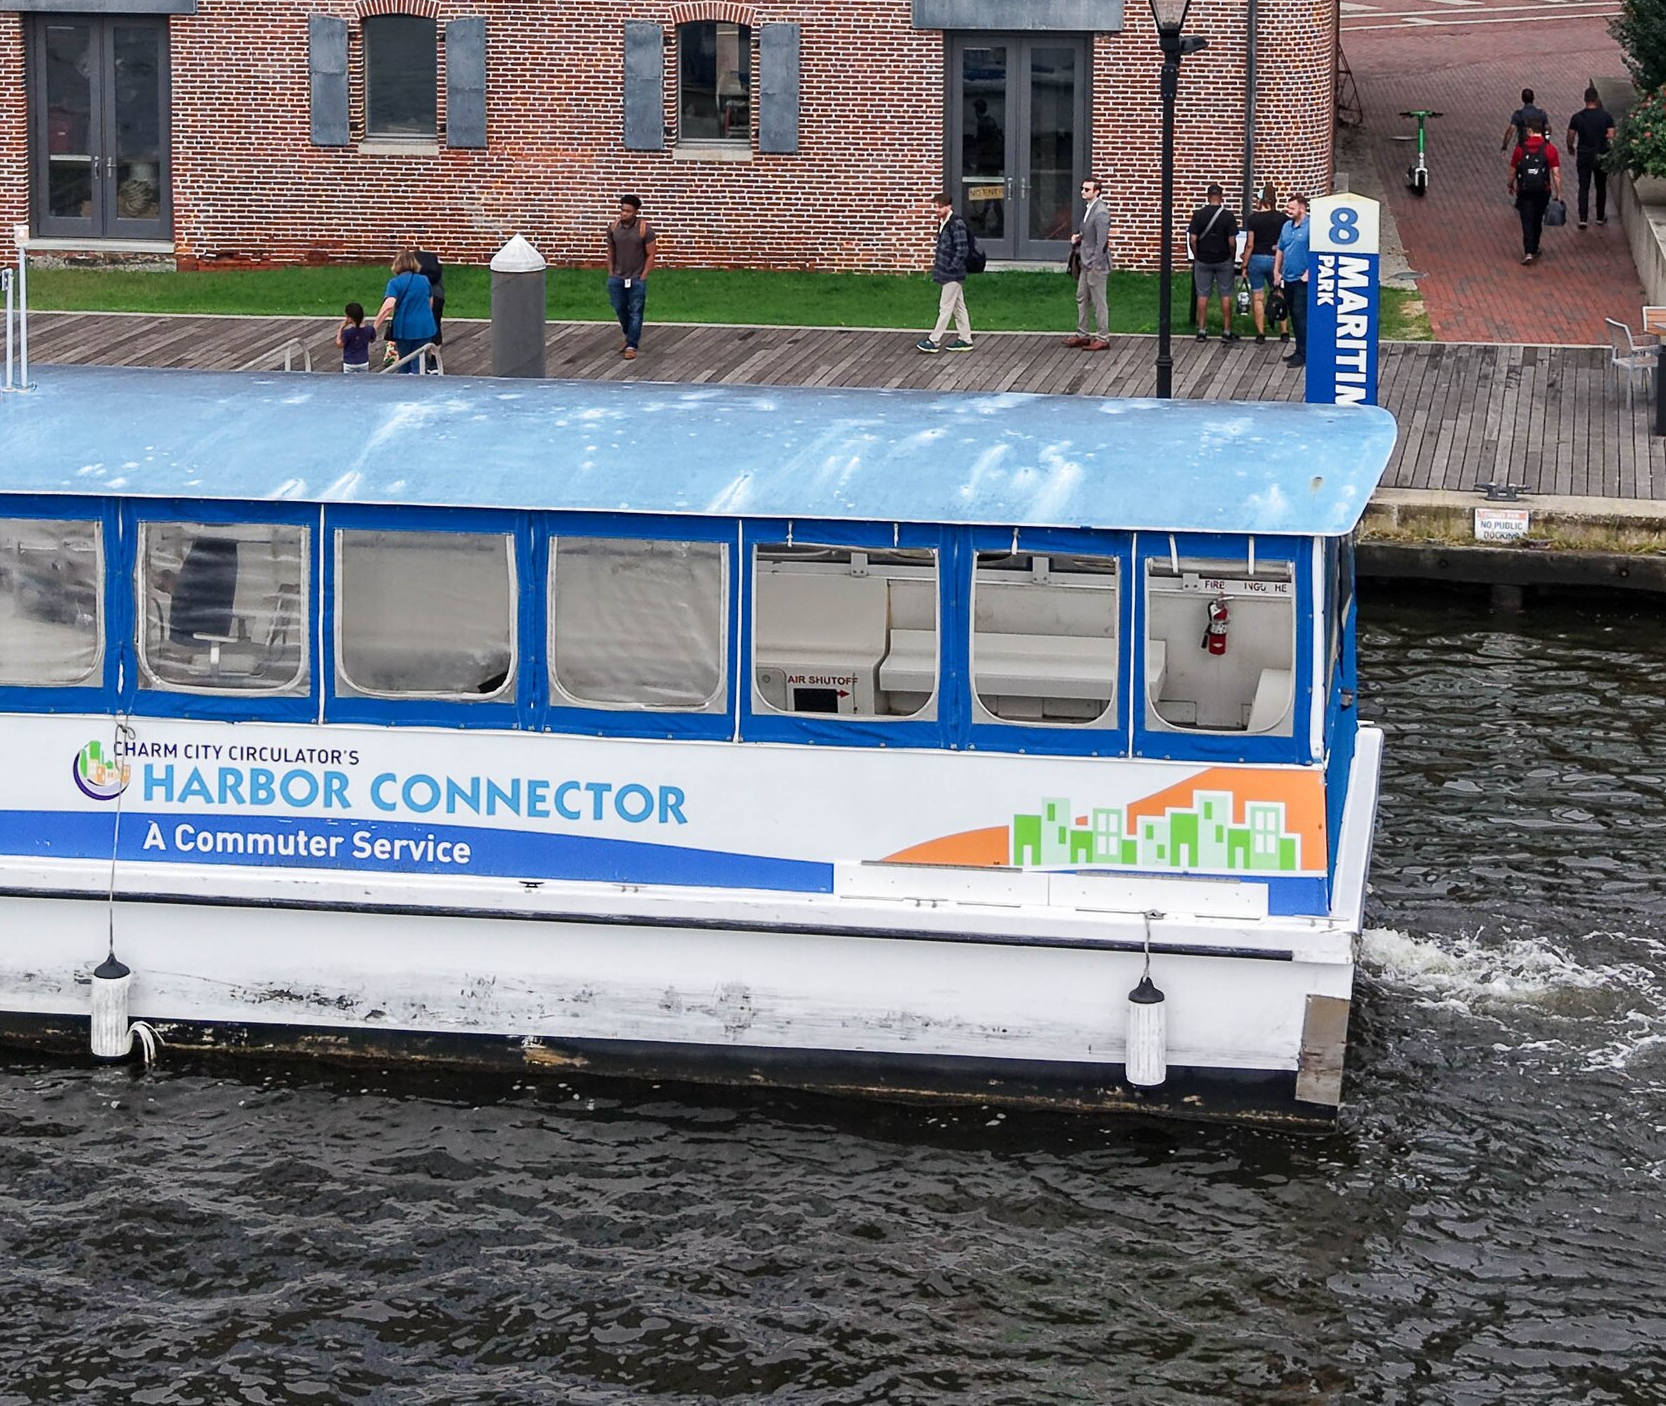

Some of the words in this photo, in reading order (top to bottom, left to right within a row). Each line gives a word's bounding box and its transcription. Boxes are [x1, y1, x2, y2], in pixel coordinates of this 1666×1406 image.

[1329, 207, 1360, 245] 8
[1317, 255, 1335, 306] PARK
[1480, 520, 1492, 529] NO
[1494, 521, 1523, 530] PUBLIC
[1205, 580, 1225, 590] FIRE
[787, 675, 806, 684] AIR
[808, 675, 859, 686] SHUTOFF
[113, 741, 178, 758] CHARM
[184, 744, 223, 761] CITY
[229, 745, 360, 766] CIRCULATOR'S
[143, 762, 353, 810] HARBOR
[370, 772, 688, 825] CONNECTOR
[143, 821, 167, 851] A
[174, 823, 345, 859] Commuter
[351, 830, 472, 865] Service
